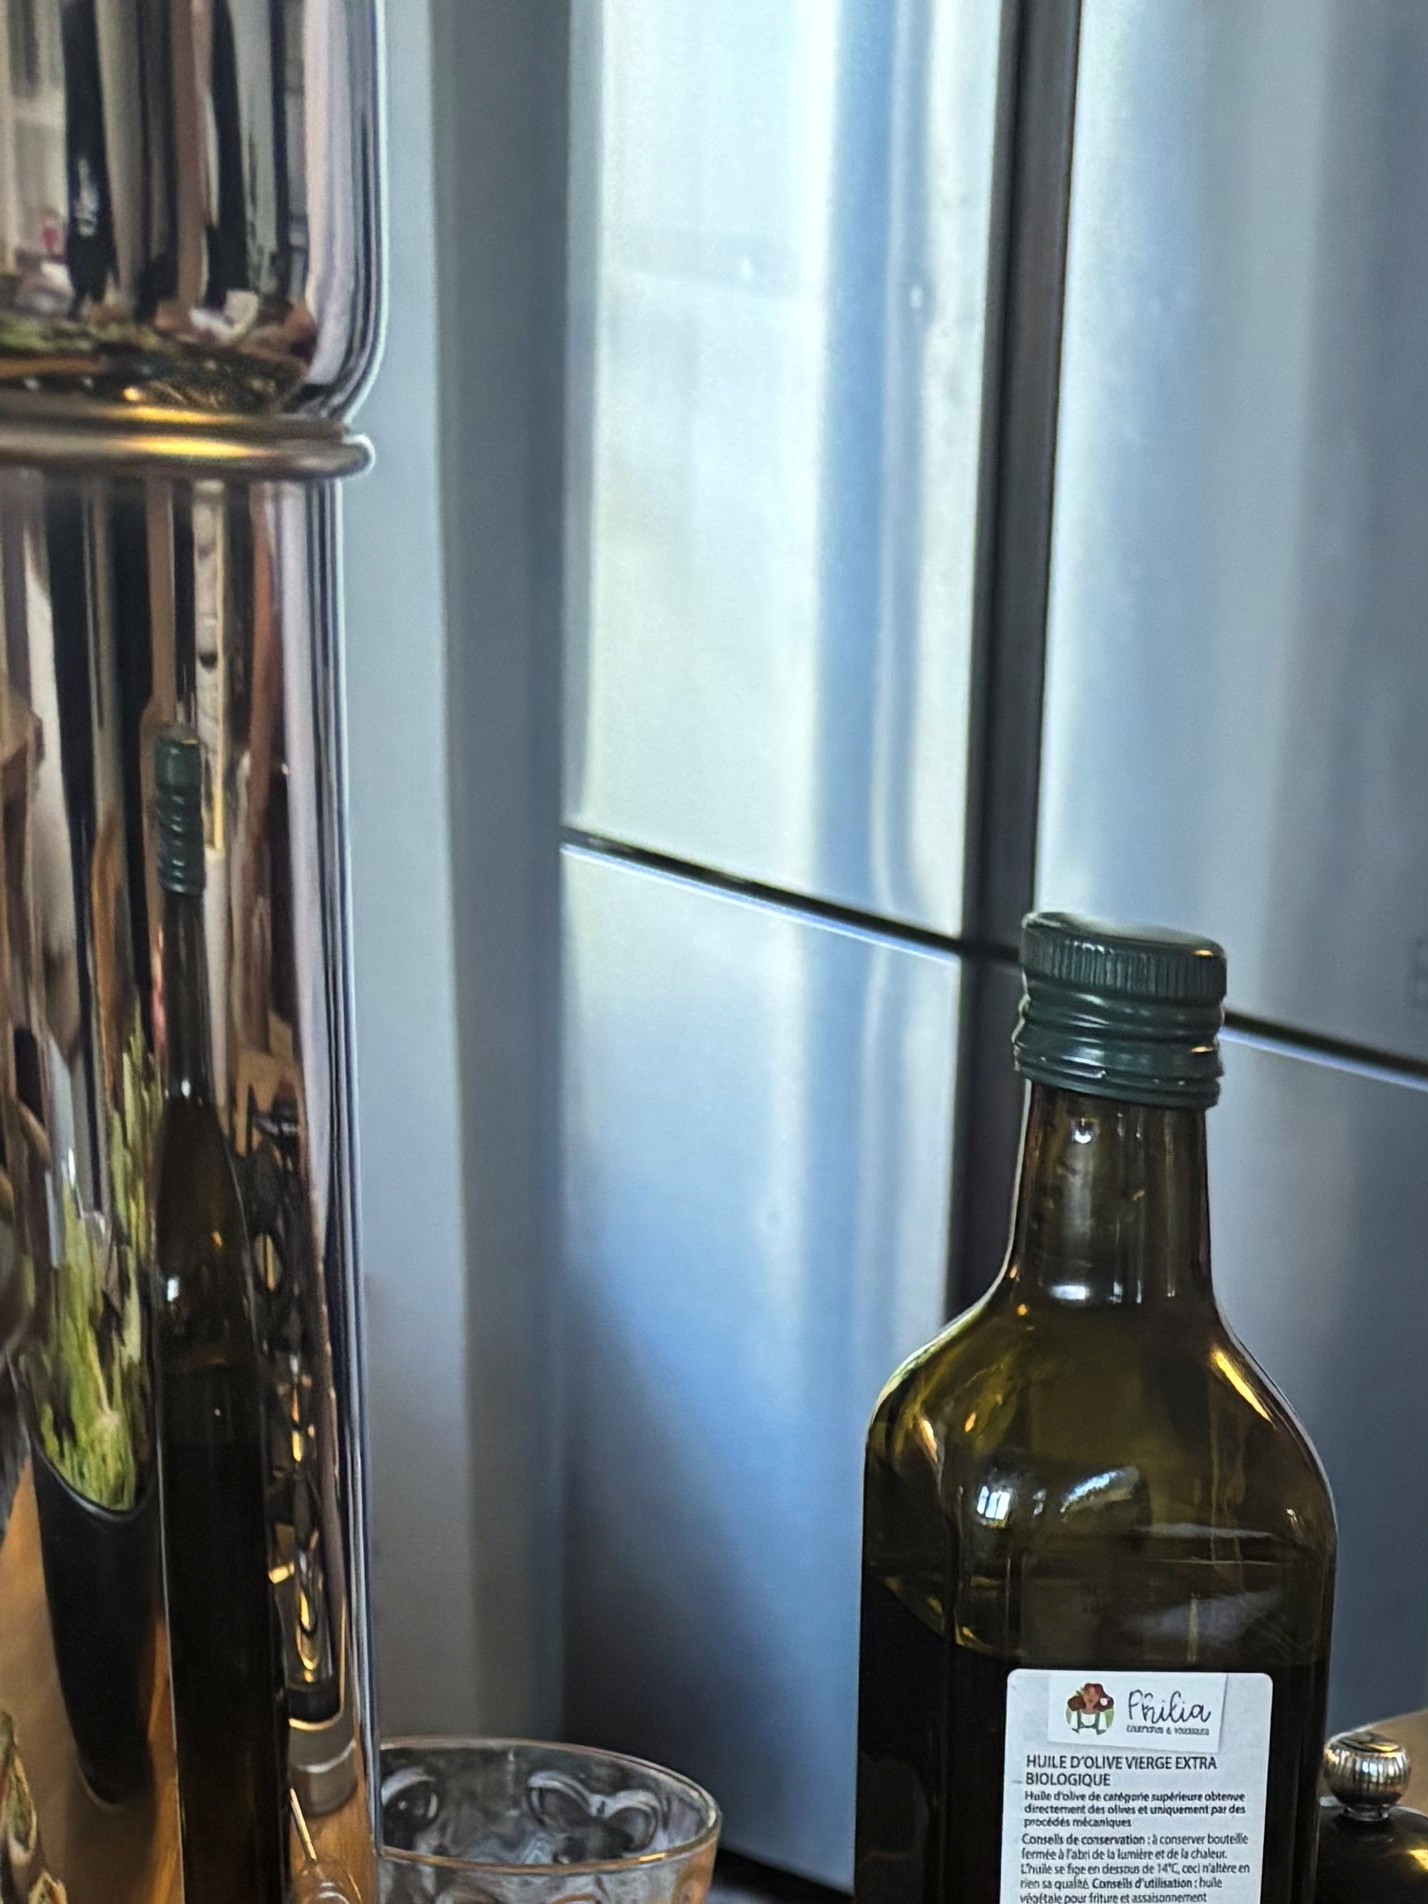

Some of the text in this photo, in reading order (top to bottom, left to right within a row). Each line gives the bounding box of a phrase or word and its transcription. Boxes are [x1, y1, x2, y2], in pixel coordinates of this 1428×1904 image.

[1128, 1688, 1212, 1724] Philia
[1026, 1755, 1217, 1770] HUILE D'OLIVE VIERGE EXTRA
[1025, 1772, 1111, 1787] BIOLOGIQUE
[1024, 1791, 1245, 1804] Huile d'olive de catégorie supérieure obtenue
[1024, 1804, 1245, 1817] directement des olives et uniquement par des
[1023, 1817, 1131, 1829] procédés mécaniques
[1022, 1833, 1064, 1845] Conseils
[1066, 1833, 1078, 1845] de
[1081, 1834, 1145, 1846] conservation
[1152, 1833, 1158, 1845] à
[1160, 1836, 1205, 1845] conserver
[1207, 1833, 1248, 1845] bouteille
[1021, 1848, 1057, 1860] fermée
[1058, 1848, 1064, 1860] à
[1066, 1848, 1090, 1860] l'abri
[1091, 1848, 1104, 1860] de
[1106, 1848, 1115, 1860] la
[1117, 1848, 1153, 1860] lumière
[1155, 1849, 1164, 1860] et
[1166, 1848, 1179, 1860] de
[1180, 1848, 1189, 1860] la
[1021, 1862, 1053, 1875] L'huile
[1054, 1865, 1065, 1875] se
[1067, 1862, 1086, 1876] fige
[1088, 1865, 1100, 1875] en
[1102, 1862, 1140, 1875] dessous
[1142, 1862, 1155, 1874] de
[1181, 1863, 1200, 1874] ceci
[1202, 1862, 1237, 1874] n'altère
[1238, 1864, 1250, 1873] en
[1020, 1878, 1040, 1889] rien
[1042, 1880, 1052, 1889] sa
[1092, 1877, 1133, 1889] Conseils
[1135, 1877, 1192, 1889] d'utilisation
[1199, 1877, 1222, 1888] huile
[1064, 1895, 1086, 1904] pour
[1088, 1893, 1119, 1904] friture
[1120, 1894, 1130, 1904] et
[1131, 1893, 1207, 1904] assaisonnement
